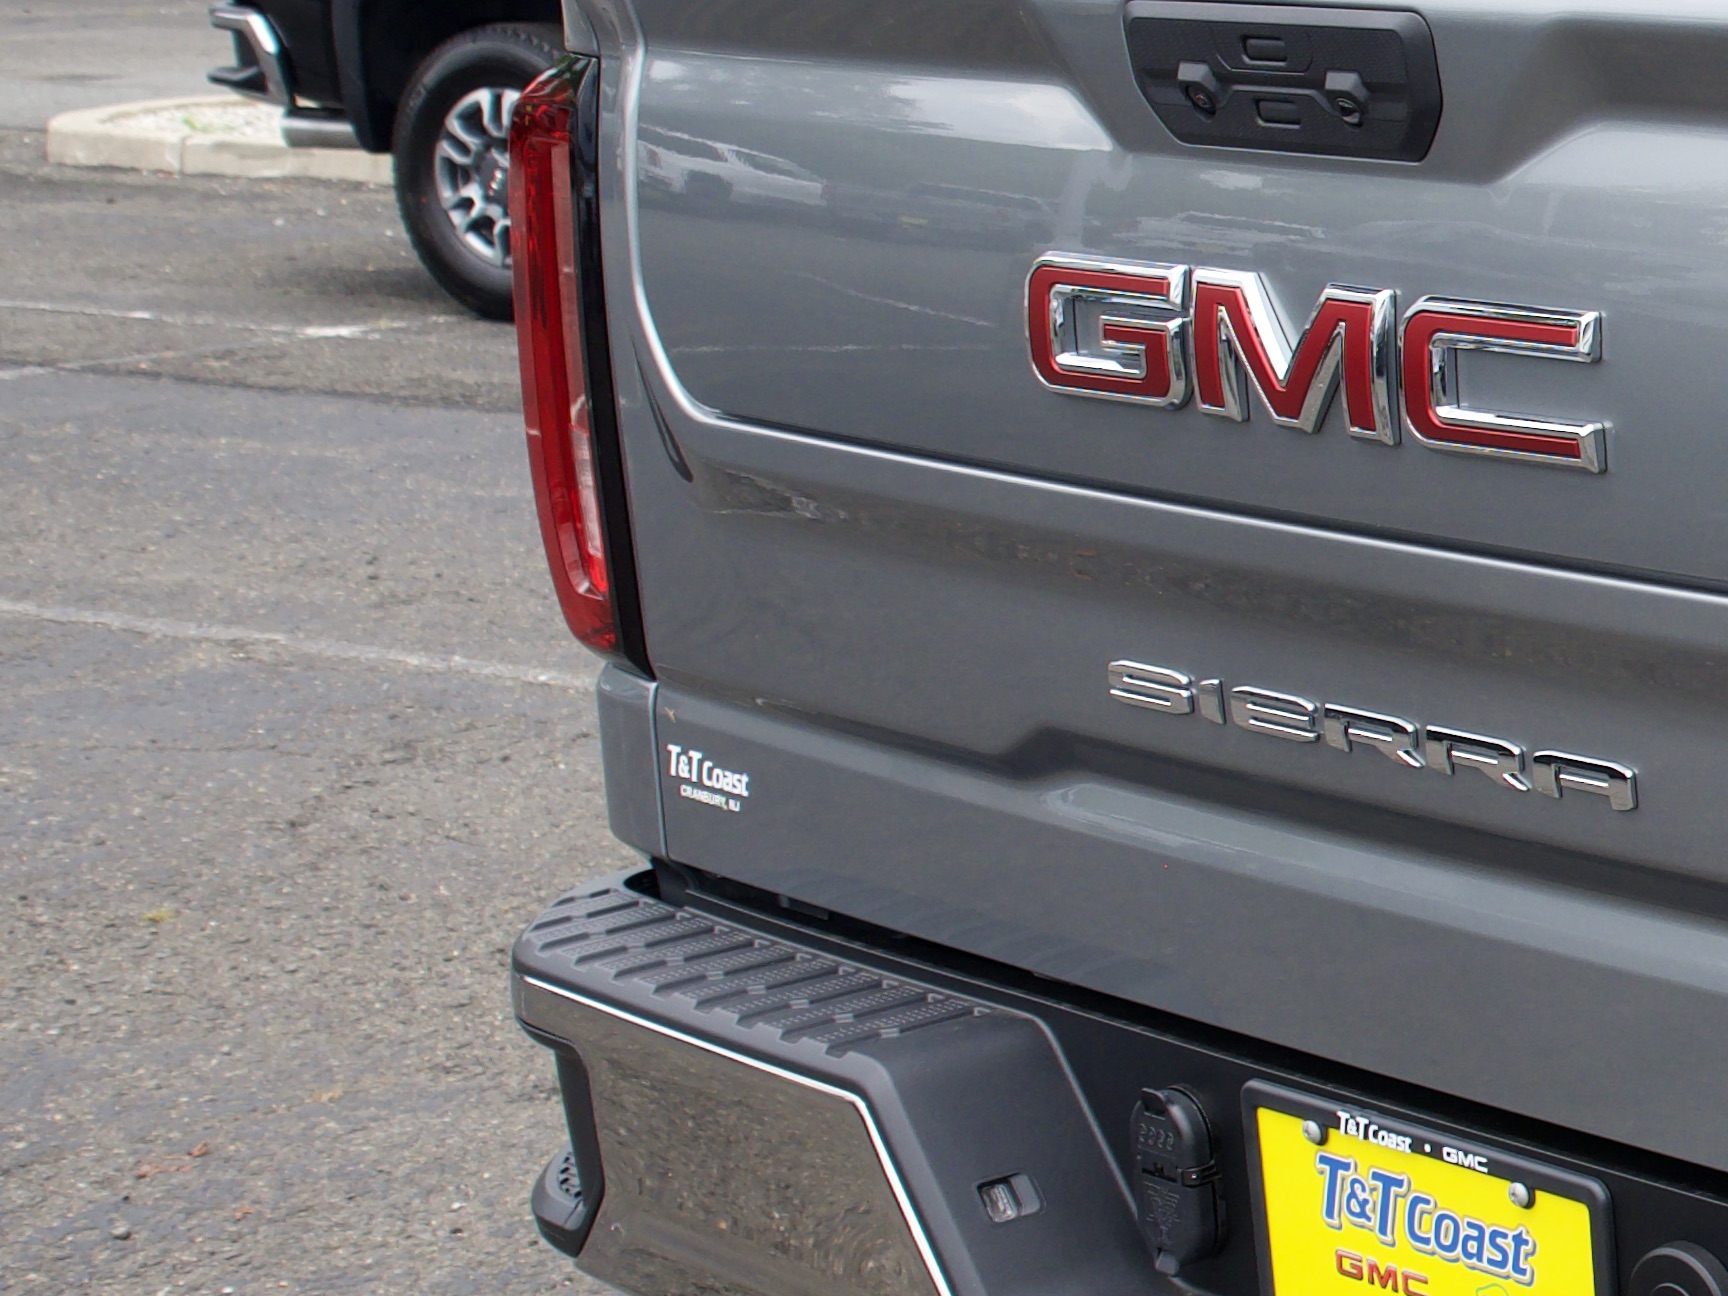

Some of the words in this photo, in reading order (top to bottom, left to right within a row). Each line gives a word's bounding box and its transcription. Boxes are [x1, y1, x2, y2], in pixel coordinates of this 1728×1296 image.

[1023, 249, 1610, 474] GMC
[702, 761, 750, 797] Coast
[1106, 659, 1639, 813] SIERRA
[728, 798, 741, 813] NJ
[1368, 1124, 1413, 1154] Coast
[1442, 1146, 1488, 1173] GMC
[1315, 1151, 1412, 1247] T&T
[1405, 1190, 1537, 1287] Coast
